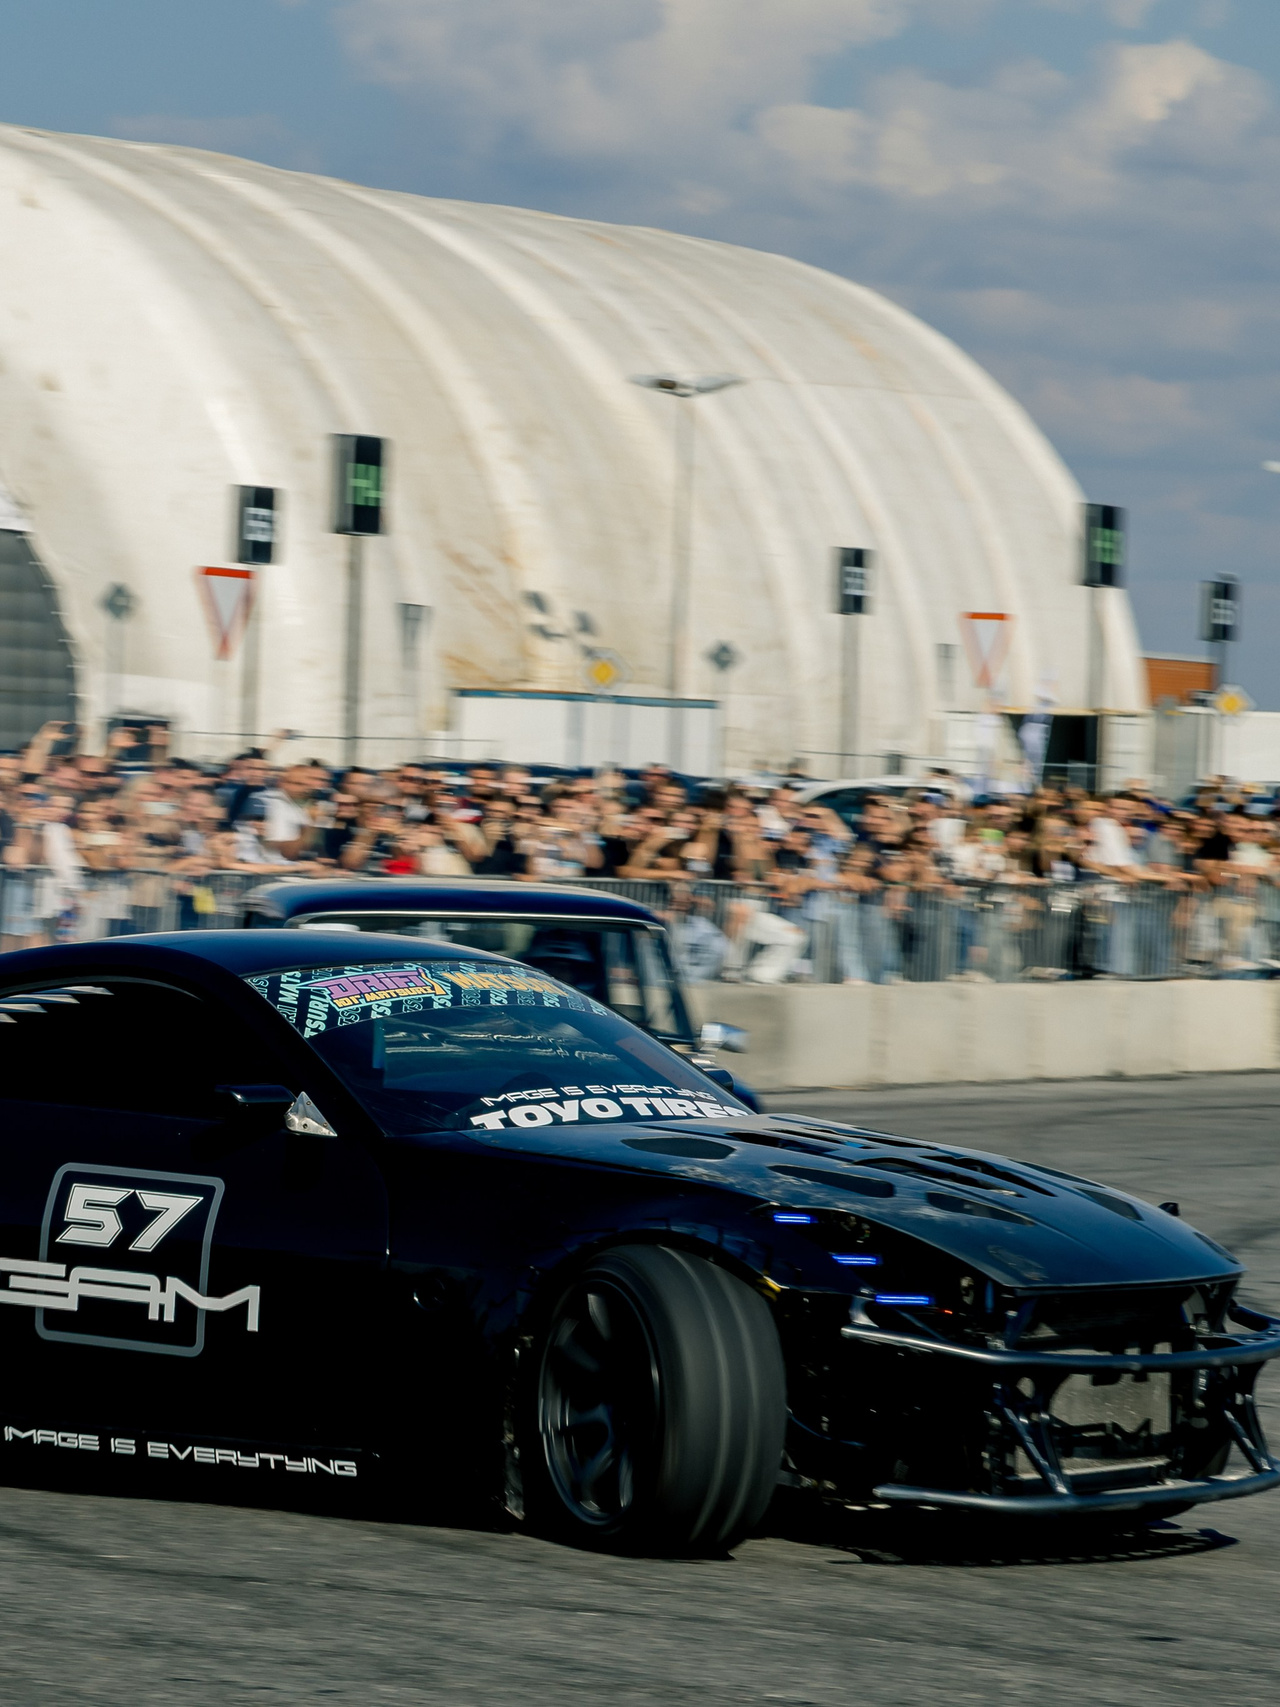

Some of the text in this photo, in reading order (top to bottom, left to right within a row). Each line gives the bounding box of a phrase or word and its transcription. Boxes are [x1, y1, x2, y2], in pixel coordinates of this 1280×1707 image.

[310, 972, 426, 999] DRIFT
[364, 986, 436, 1002] MATSURI
[479, 1087, 560, 1107] IMAGE
[560, 1085, 586, 1097] IS
[469, 1098, 624, 1131] TOYO
[55, 1182, 205, 1253] 57
[3, 1425, 100, 1451] IMAGE
[110, 1437, 136, 1456] IS
